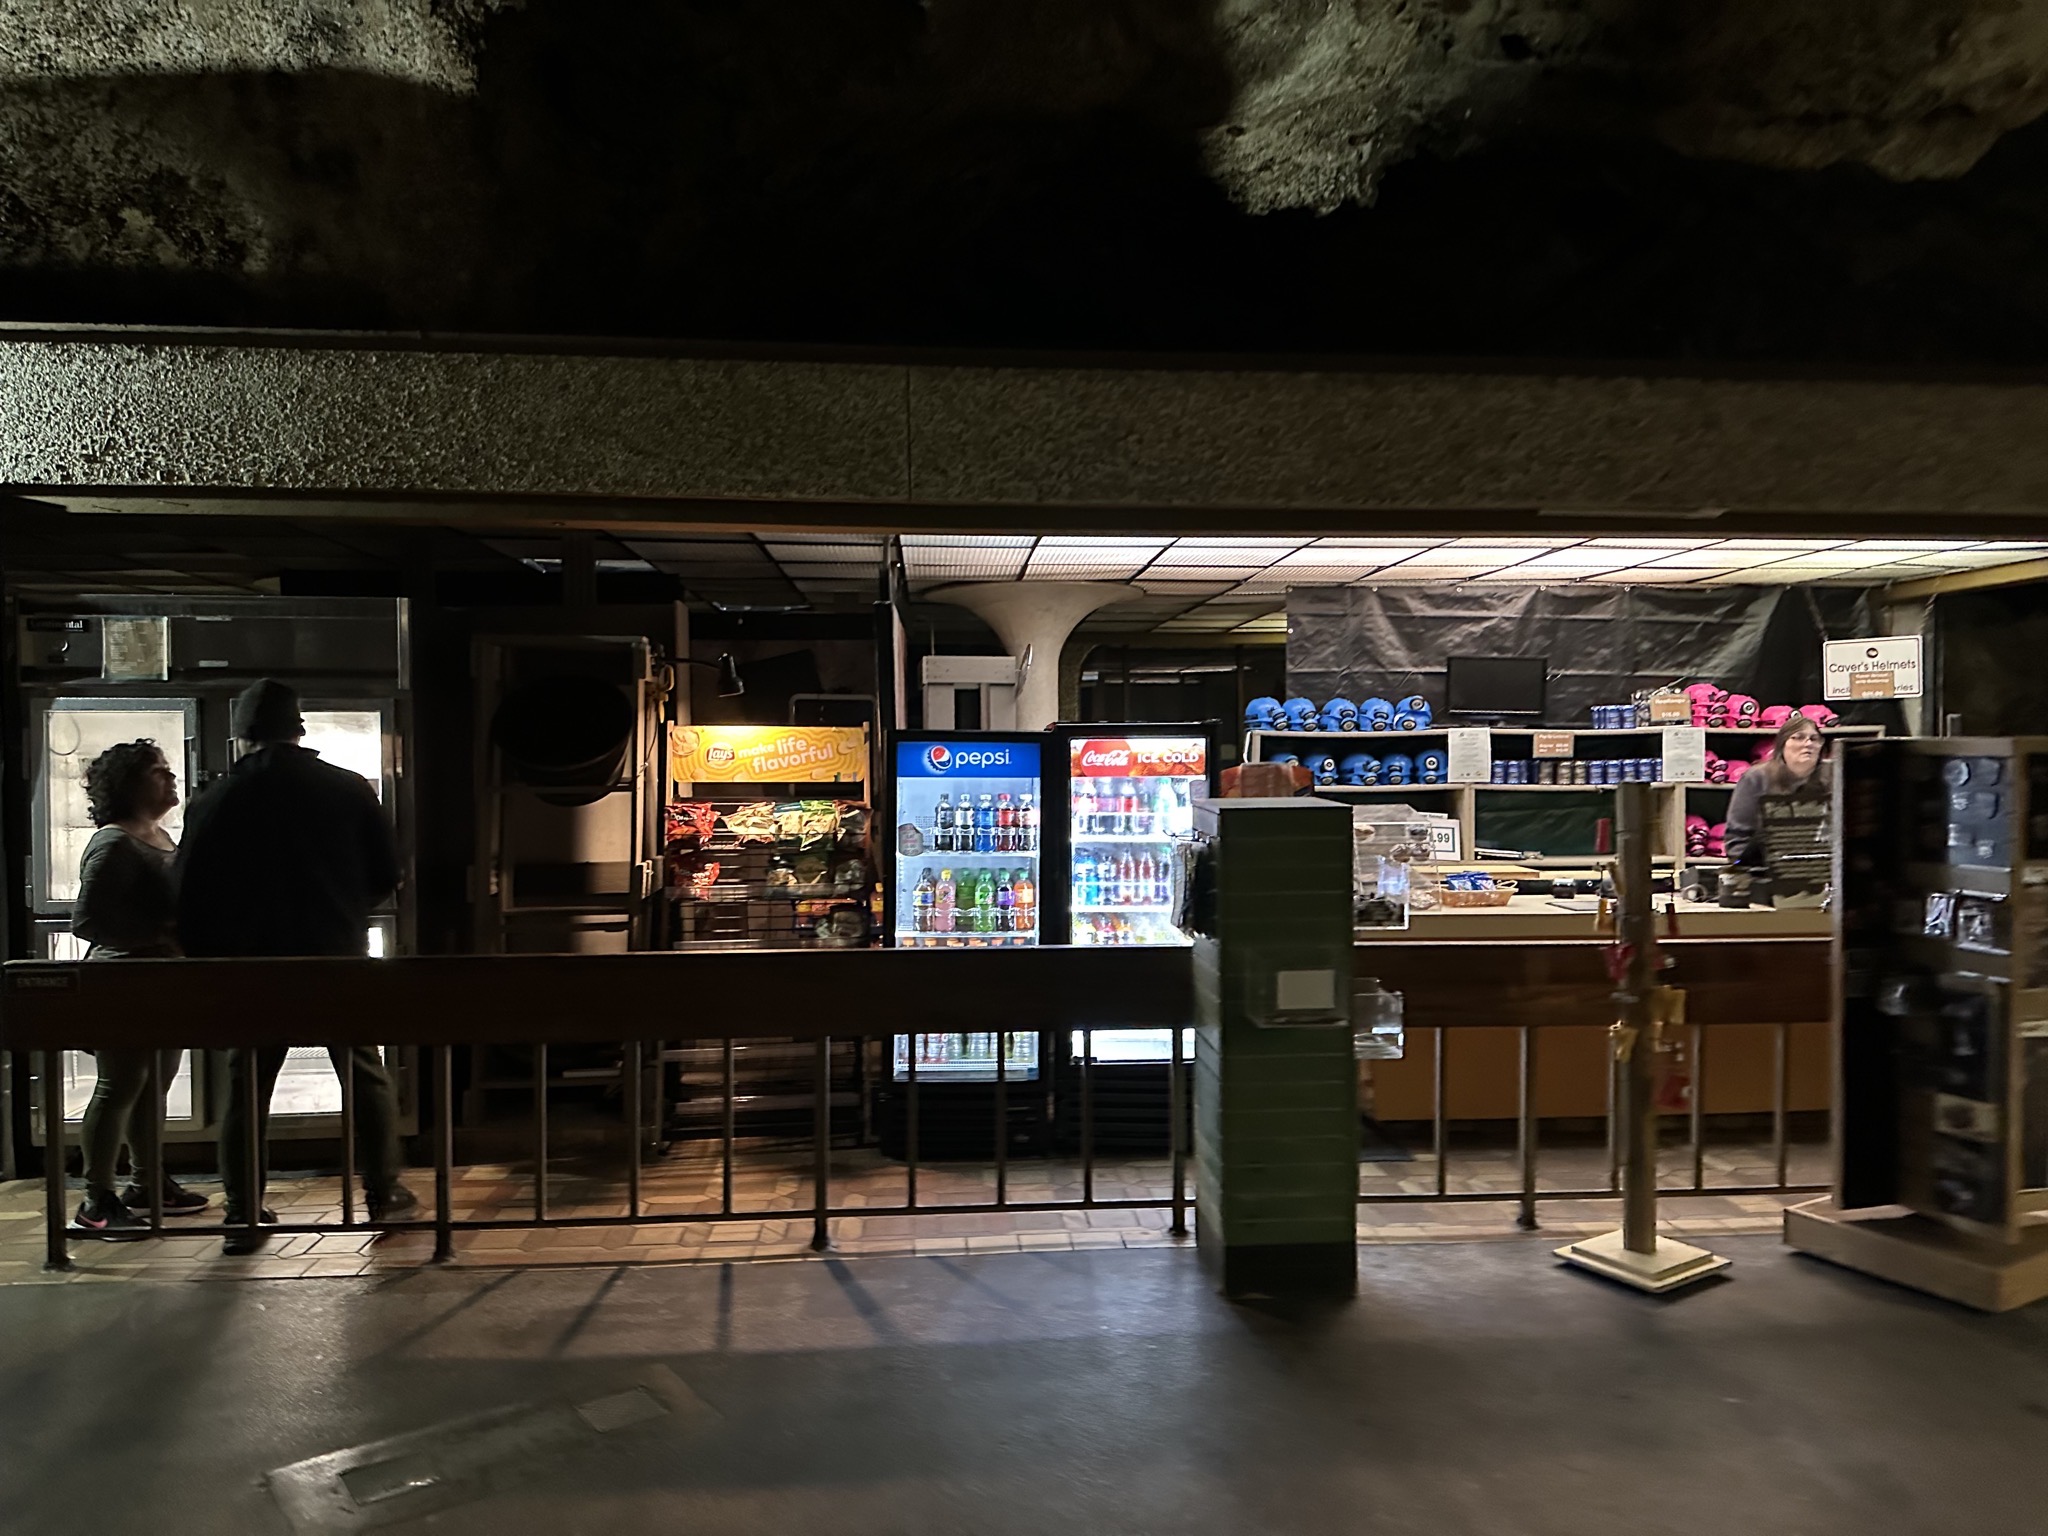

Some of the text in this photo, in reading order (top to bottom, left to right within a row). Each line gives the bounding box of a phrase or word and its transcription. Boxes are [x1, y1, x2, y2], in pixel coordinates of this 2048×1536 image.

[1829, 660, 1916, 673] Caver's Helmets
[738, 737, 807, 758] make life
[752, 743, 834, 773] flavorful
[955, 749, 1009, 769] pepsi
[1138, 753, 1199, 764] ICE COLD
